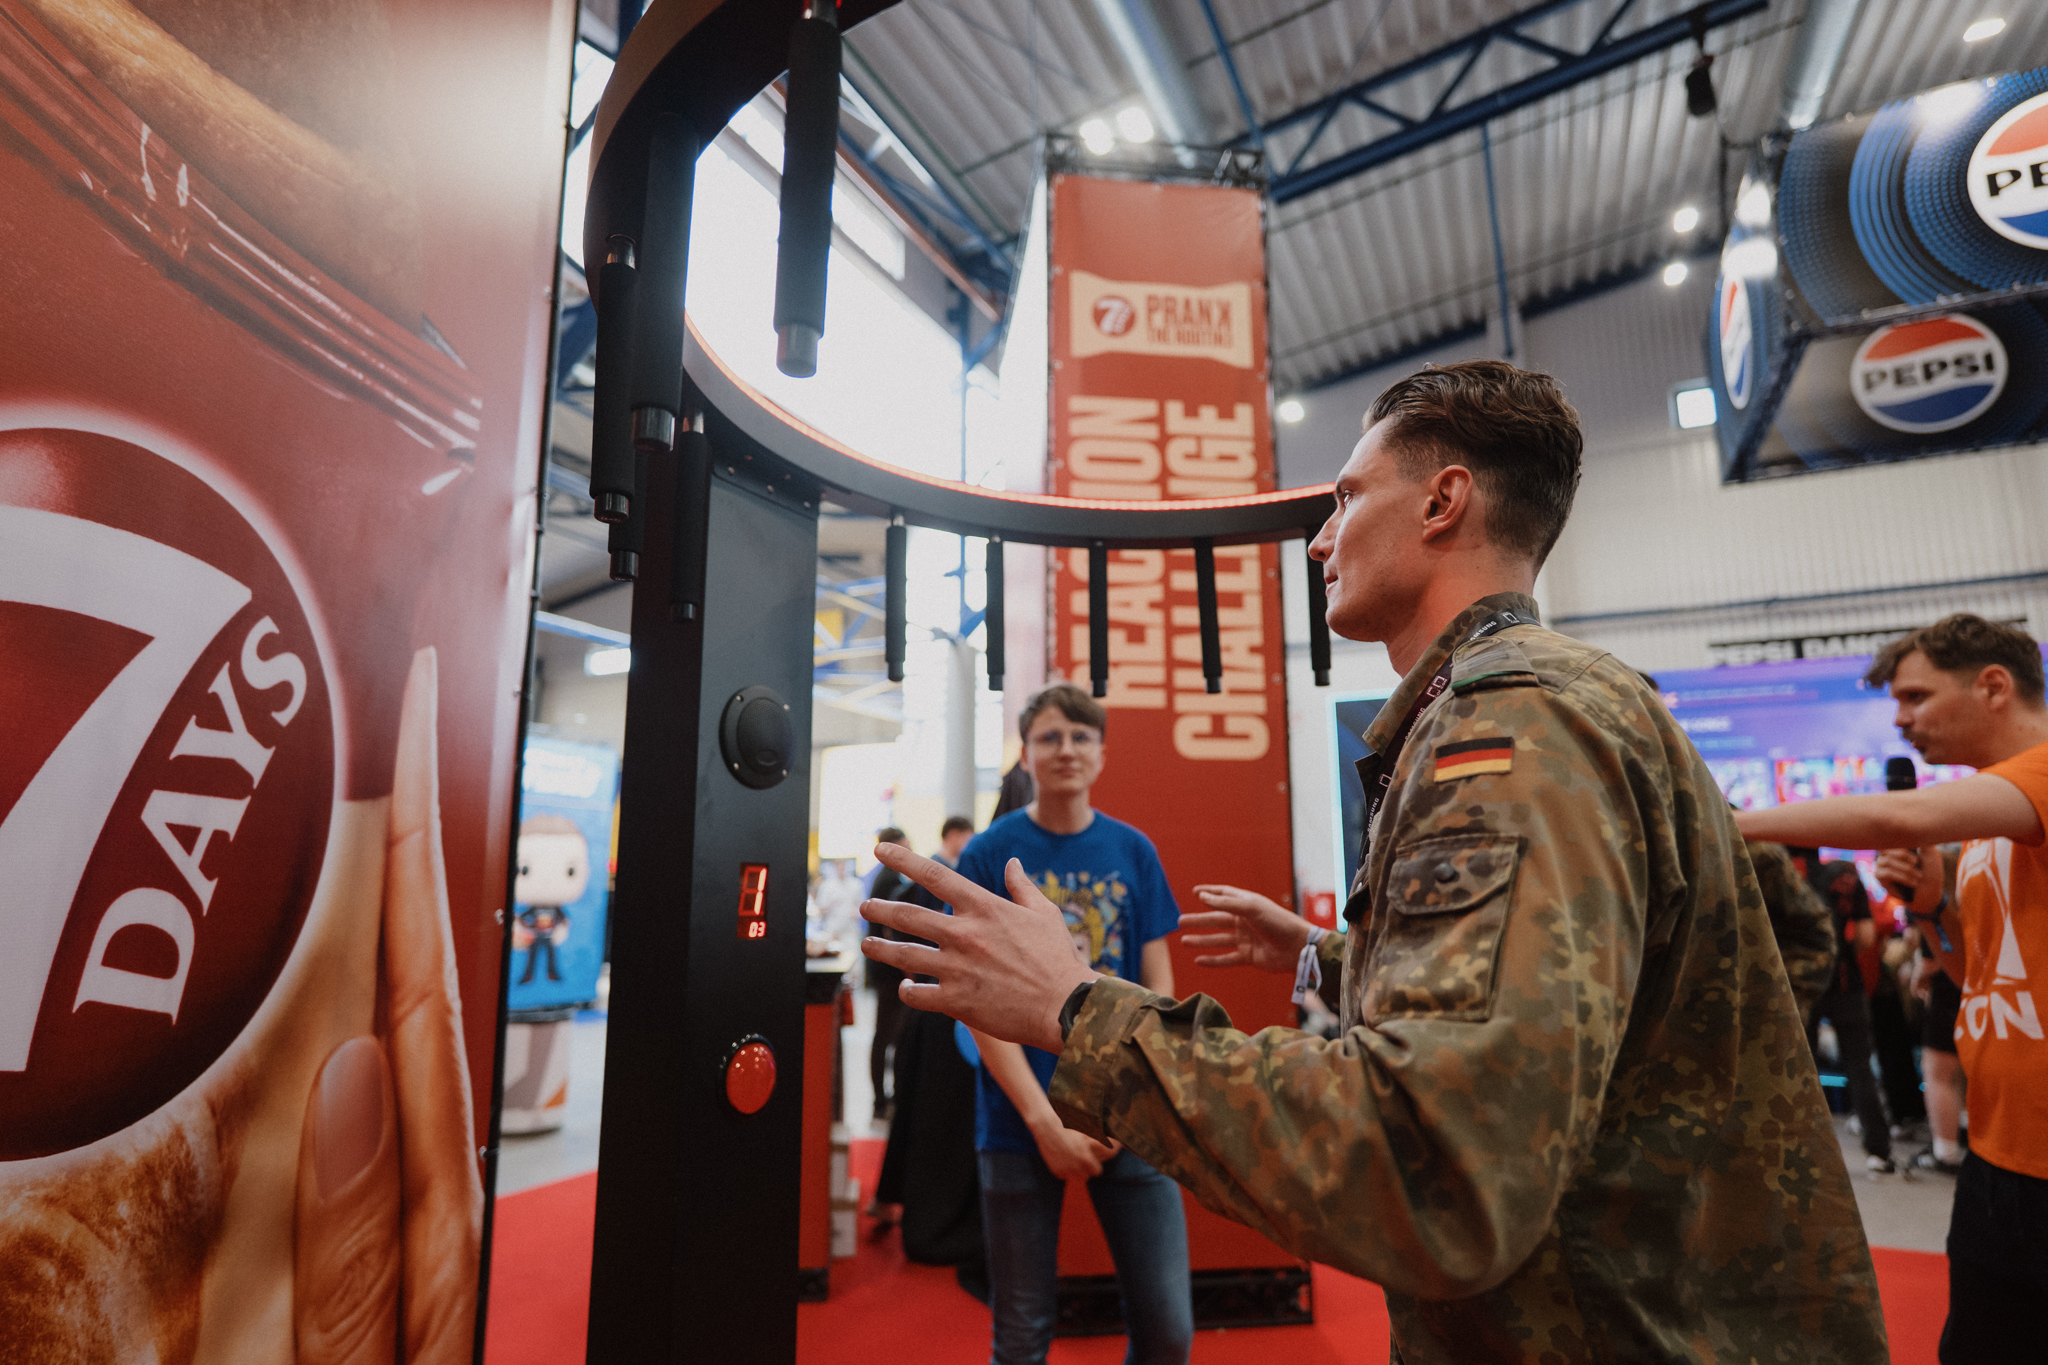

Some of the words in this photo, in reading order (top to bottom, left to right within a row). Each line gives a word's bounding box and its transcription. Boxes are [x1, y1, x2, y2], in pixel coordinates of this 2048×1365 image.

[1863, 351, 1995, 392] PEPSI
[1067, 395, 1167, 709] REACION
[1469, 620, 1497, 641] AMSUNG
[0, 506, 252, 1072] 7
[71, 614, 308, 1026] DAYS
[754, 867, 768, 915] 1
[748, 921, 767, 938] 03
